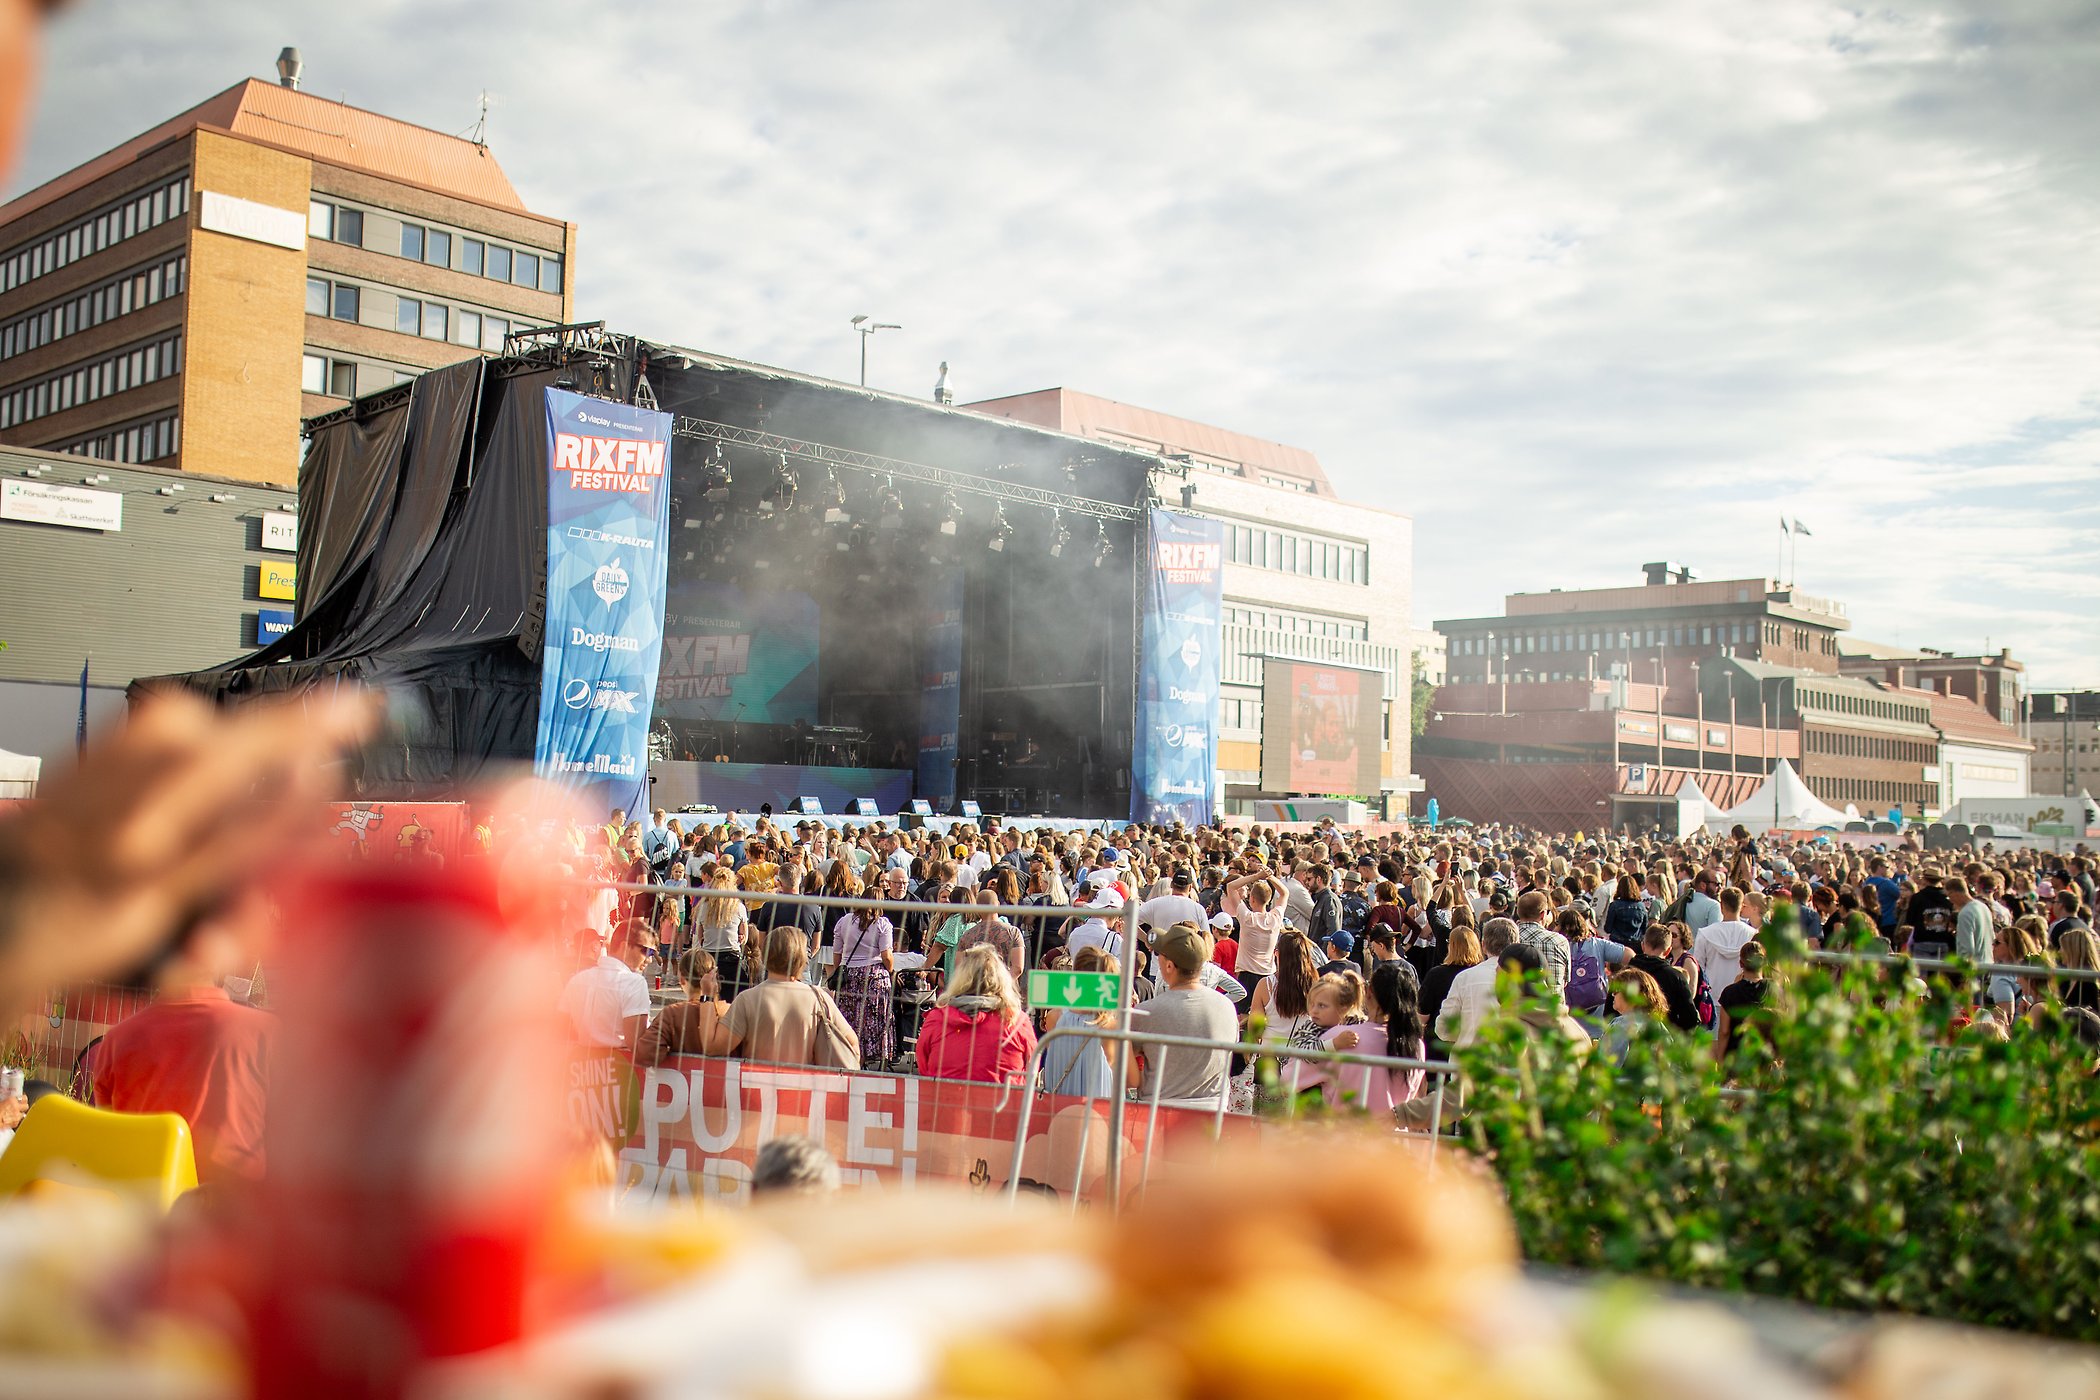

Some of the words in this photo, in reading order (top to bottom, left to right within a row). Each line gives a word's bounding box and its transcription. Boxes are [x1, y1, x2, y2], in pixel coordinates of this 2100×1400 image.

[588, 415, 611, 428] viaplay
[555, 433, 665, 476] RIXFM
[571, 471, 650, 491] FESTIVAL
[23, 490, 93, 504] Försäkringskassan
[70, 513, 114, 524] Skatteverket
[271, 526, 294, 536] RIT
[600, 532, 654, 549] K-RAUTA
[1159, 543, 1220, 569] RIXFM
[268, 572, 295, 587] Pres
[602, 572, 621, 583] DAILY
[1168, 570, 1212, 584] FESTIVAL
[596, 582, 624, 594] GREENS
[683, 615, 741, 629] PRESENTERAR
[571, 627, 639, 652] Dogman
[596, 680, 617, 689] pepsi
[590, 689, 640, 714] MAX
[551, 752, 635, 775] HomeMaid
[1631, 768, 1641, 780] P
[1970, 812, 2024, 825] EKMAN
[569, 1056, 618, 1088] SHINE
[567, 1084, 626, 1139] ON!
